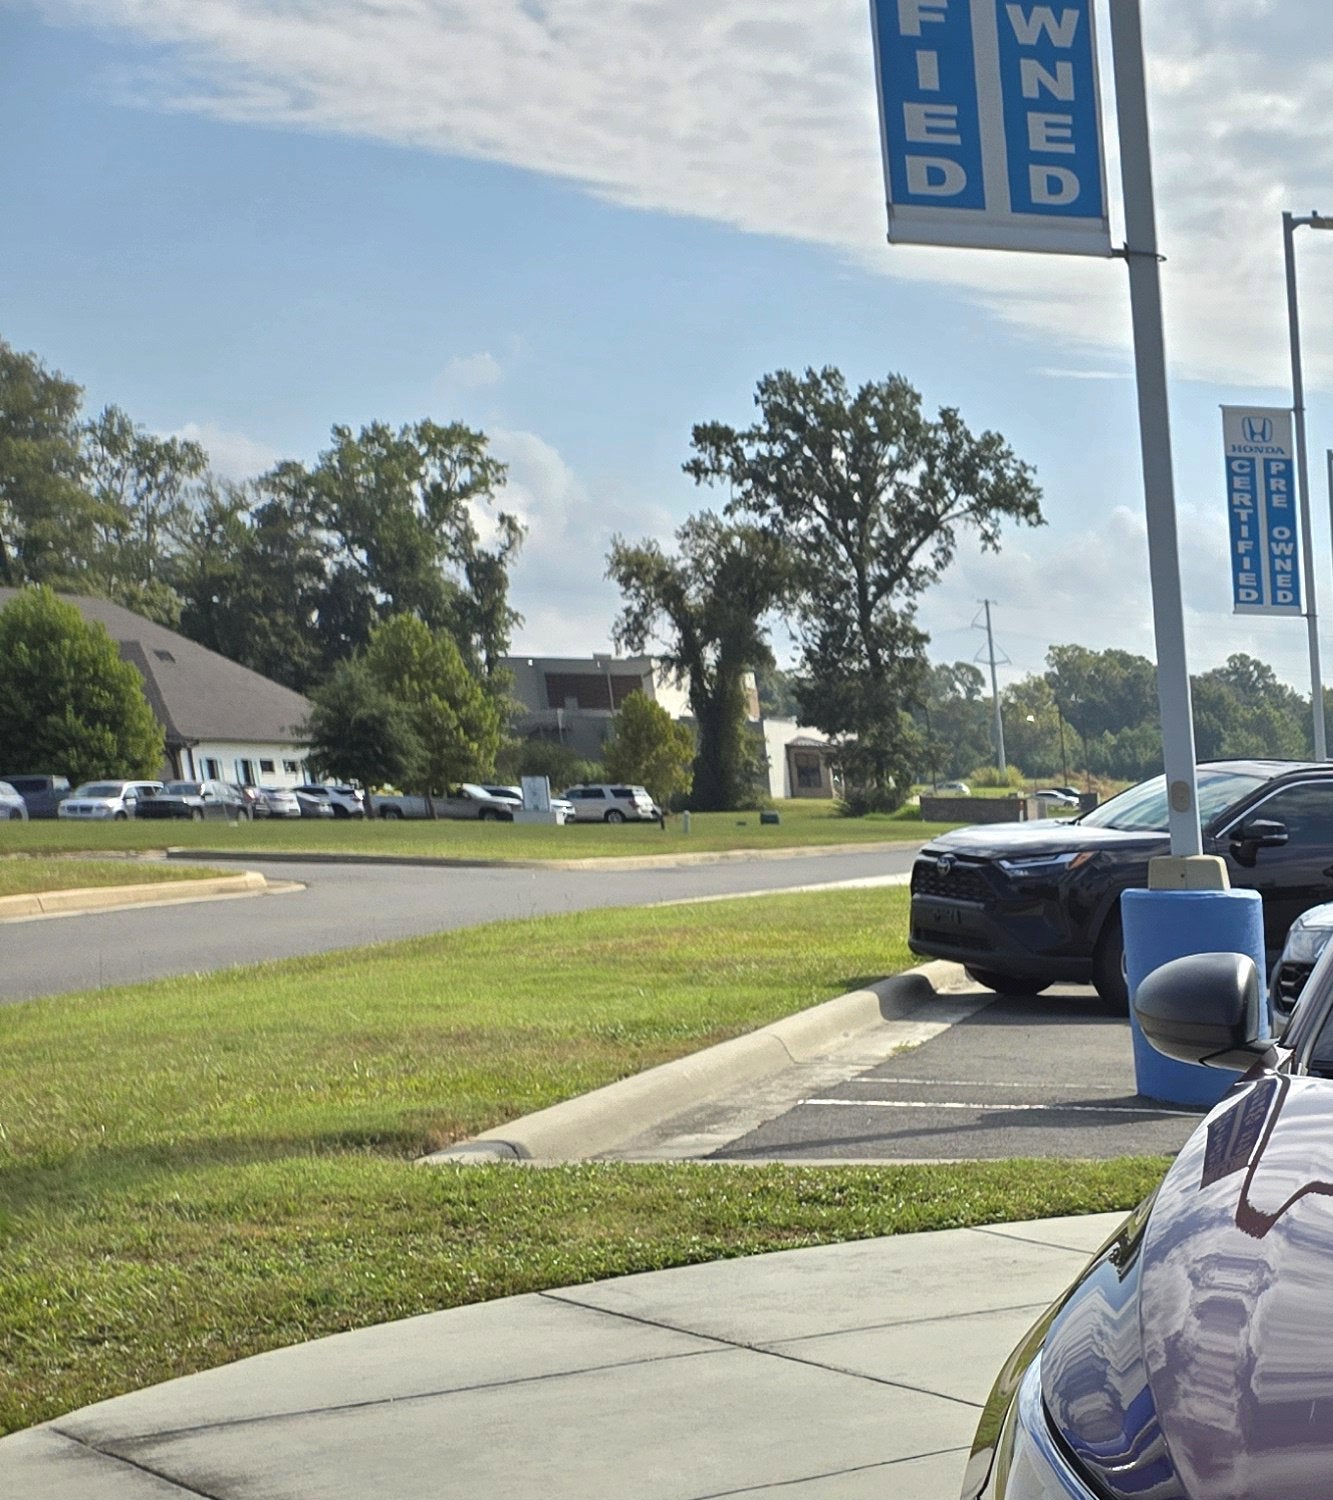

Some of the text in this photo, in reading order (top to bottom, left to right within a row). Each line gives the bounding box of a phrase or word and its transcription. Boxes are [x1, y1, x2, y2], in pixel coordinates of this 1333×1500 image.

[1231, 444, 1285, 454] HONDA
[1231, 459, 1259, 602] CERTIFIED
[1270, 461, 1294, 604] PRE OWNED
